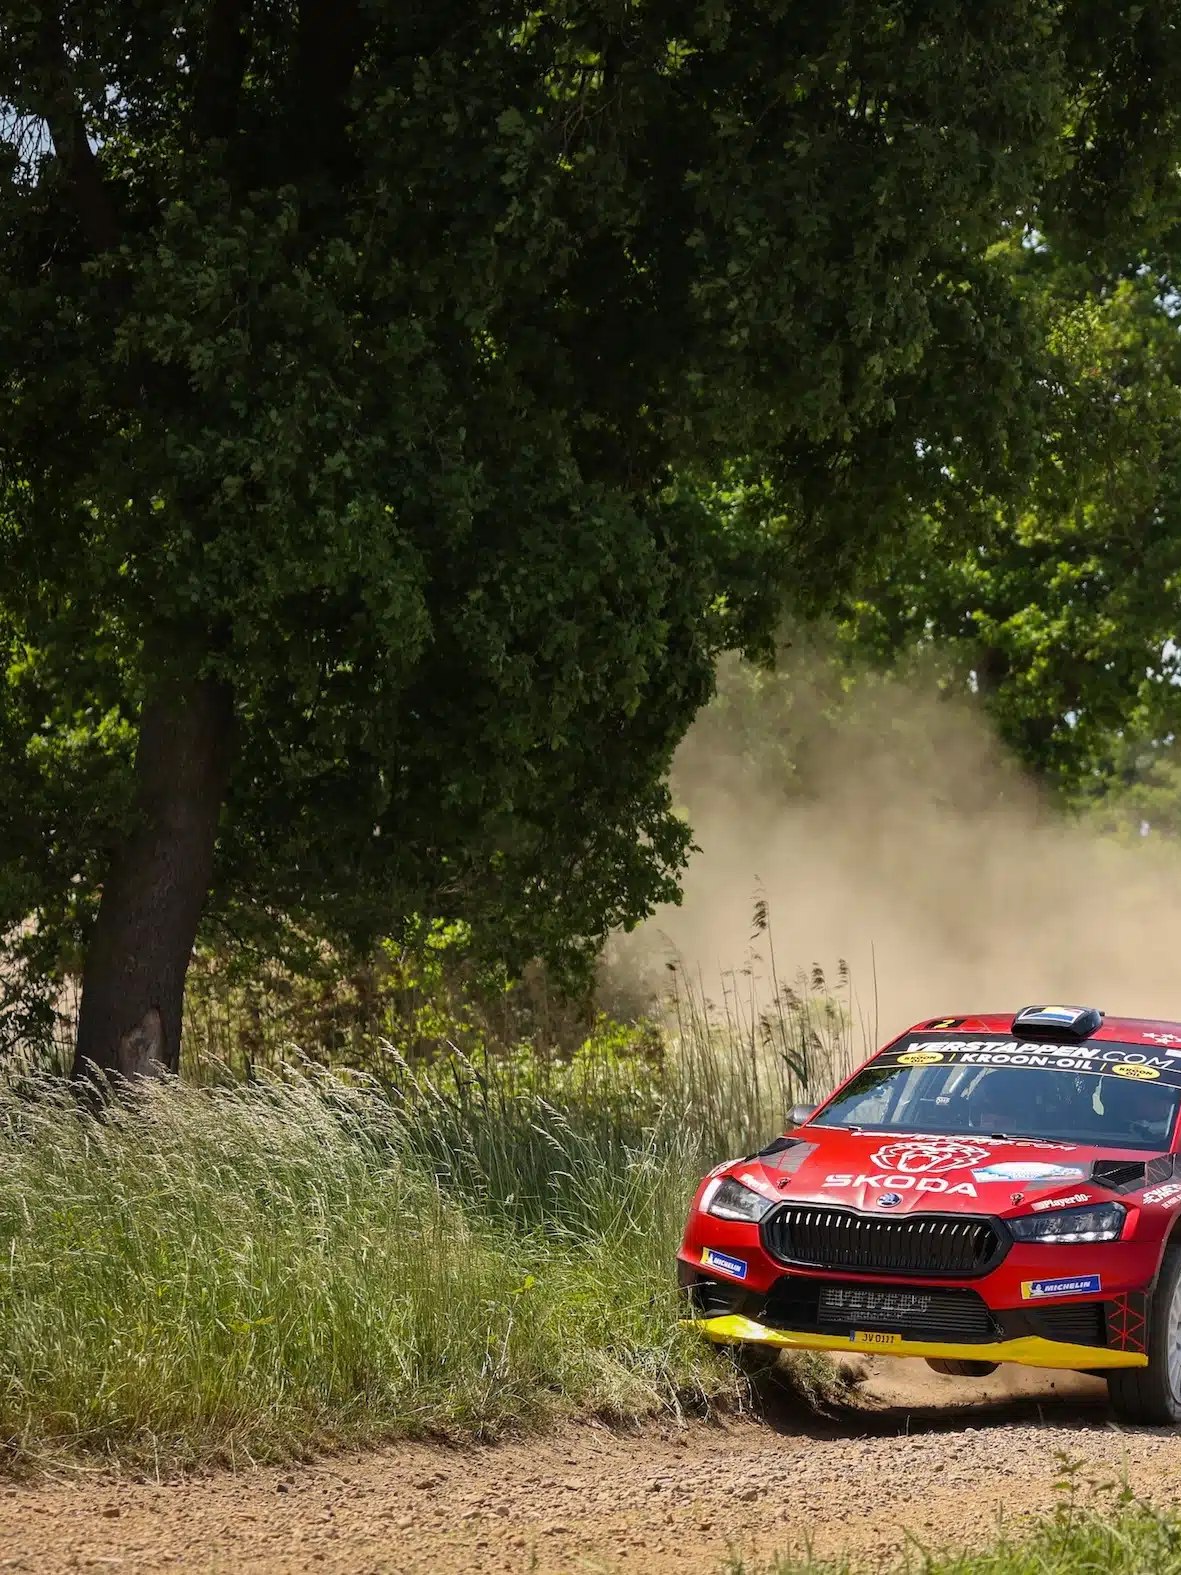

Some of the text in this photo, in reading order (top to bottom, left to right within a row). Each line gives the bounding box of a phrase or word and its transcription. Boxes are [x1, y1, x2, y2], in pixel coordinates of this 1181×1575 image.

[934, 1019, 955, 1029] 2
[906, 1041, 1175, 1069] VERSTAPPEN.COM
[960, 1052, 1093, 1070] KROON-OIL
[1119, 1066, 1153, 1076] KROON
[714, 1256, 742, 1272] MICHELIN
[1044, 1281, 1091, 1292] MICHELIN
